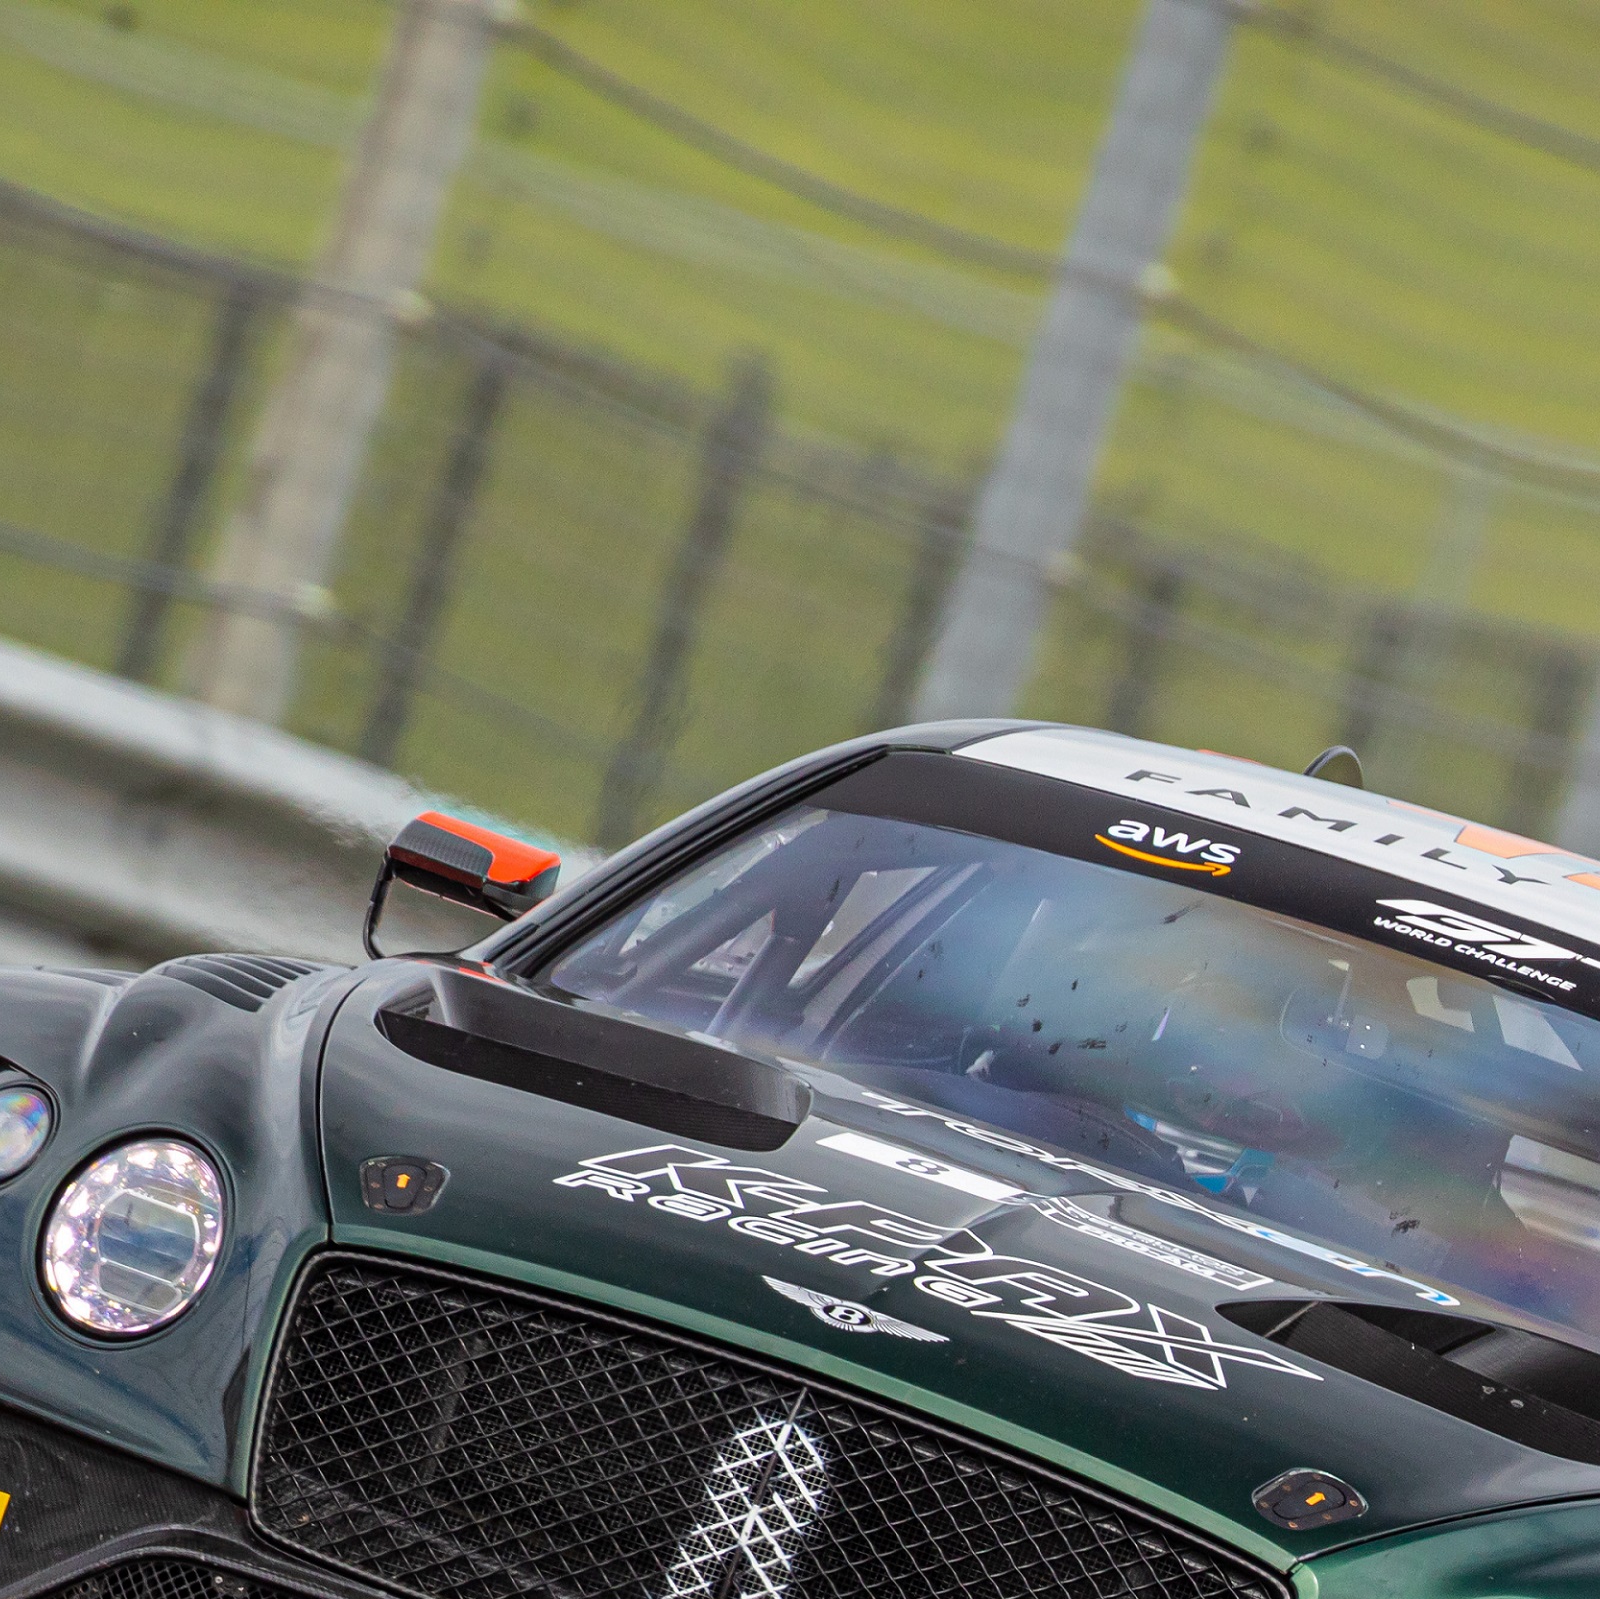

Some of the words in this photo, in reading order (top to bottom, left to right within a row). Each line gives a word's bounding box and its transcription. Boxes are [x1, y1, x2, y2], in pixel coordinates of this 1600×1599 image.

[1107, 818, 1242, 867] aws
[1125, 769, 1550, 887] FAMILY
[1374, 916, 1452, 948] WORLD
[1453, 939, 1577, 992] CHALLENGE
[895, 1158, 949, 1176] 8
[1078, 1224, 1216, 1276] PRO-AM
